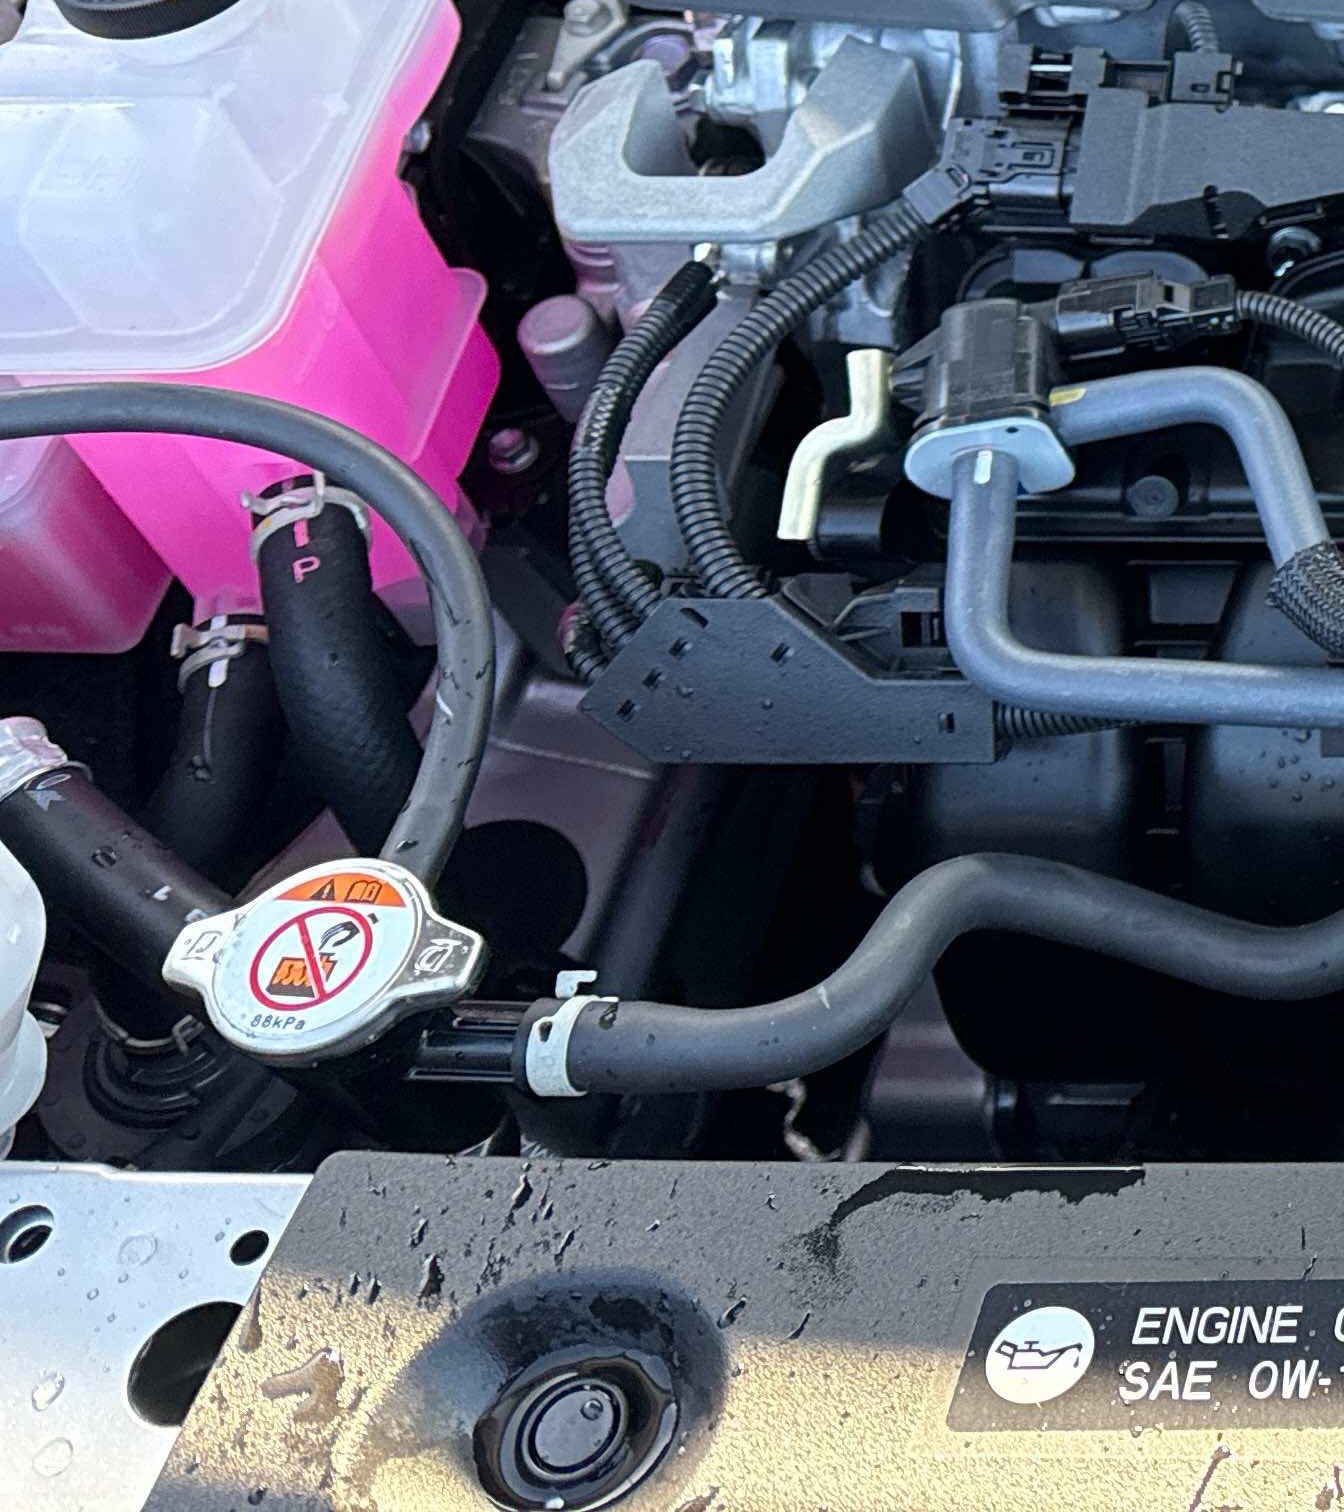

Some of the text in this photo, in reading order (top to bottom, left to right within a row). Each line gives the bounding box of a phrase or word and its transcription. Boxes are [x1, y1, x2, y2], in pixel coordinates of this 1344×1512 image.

[293, 555, 321, 584] P
[250, 1013, 306, 1030] 88kPa
[1131, 1305, 1303, 1345] ENGINE
[1119, 1360, 1218, 1400] SAE
